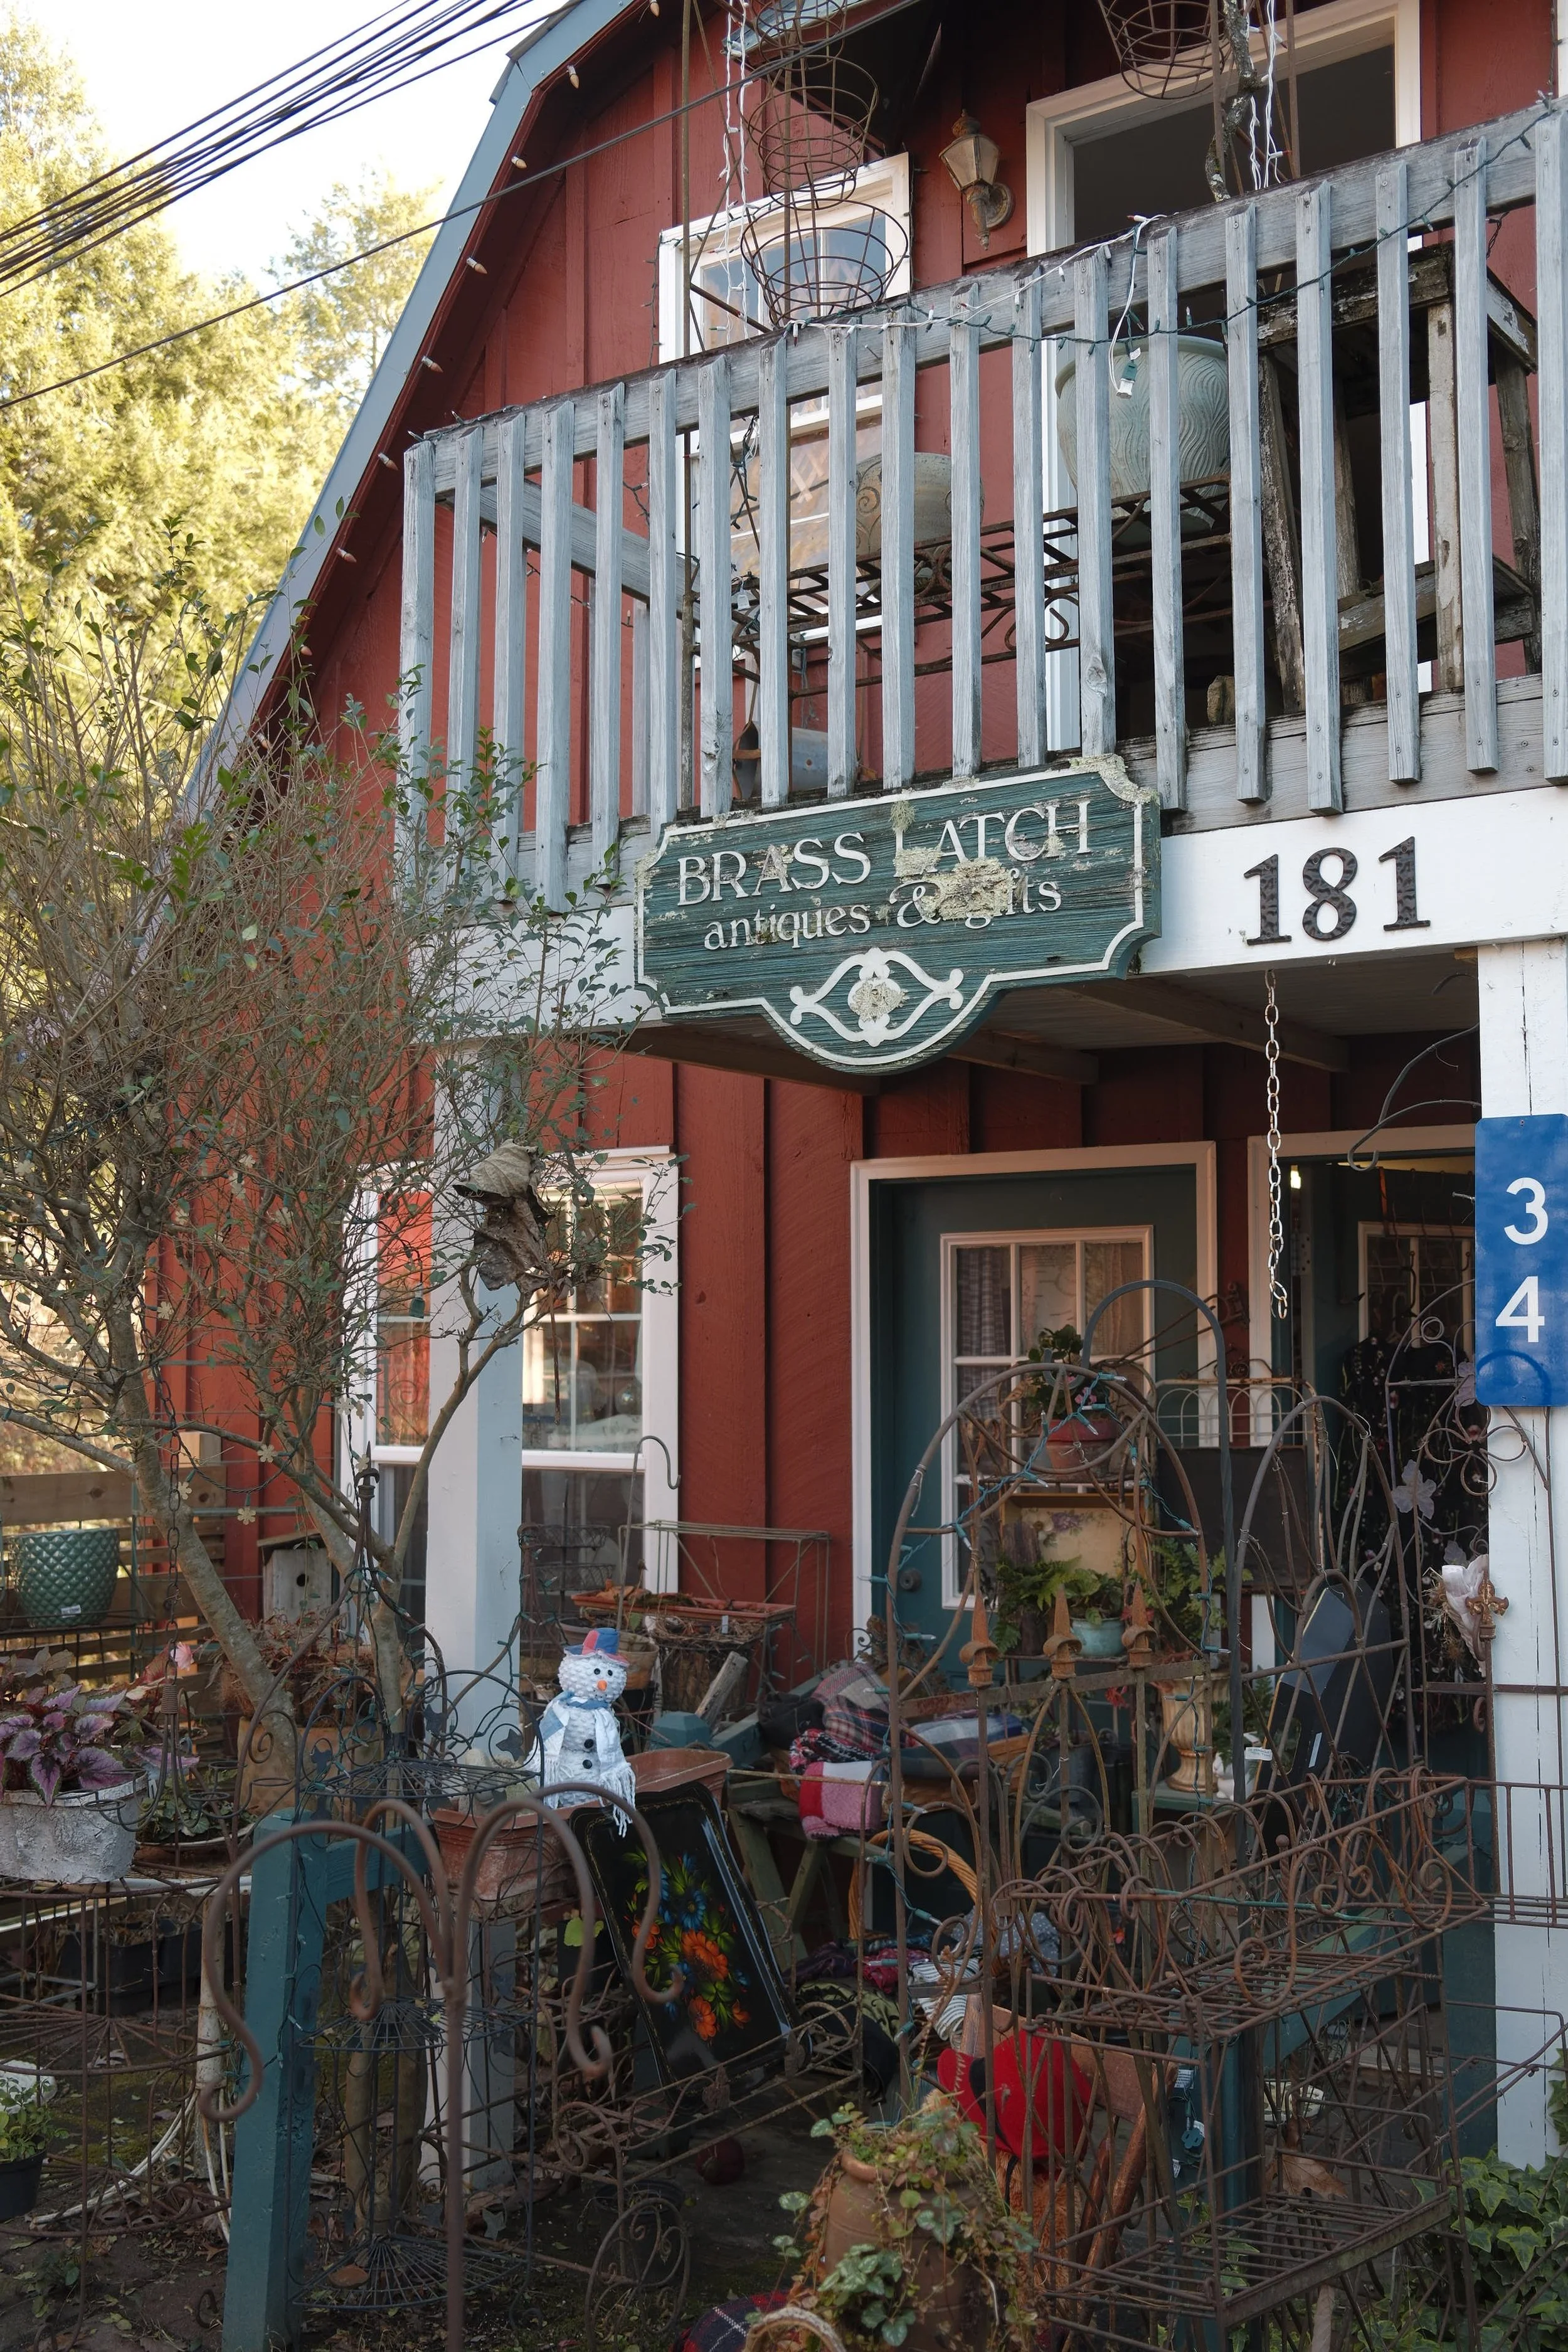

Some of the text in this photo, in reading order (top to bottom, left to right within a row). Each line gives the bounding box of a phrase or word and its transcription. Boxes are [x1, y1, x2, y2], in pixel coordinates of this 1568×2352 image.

[677, 832, 871, 906] BRASS
[704, 867, 1062, 950] antiques & fts
[1243, 836, 1431, 946] 181
